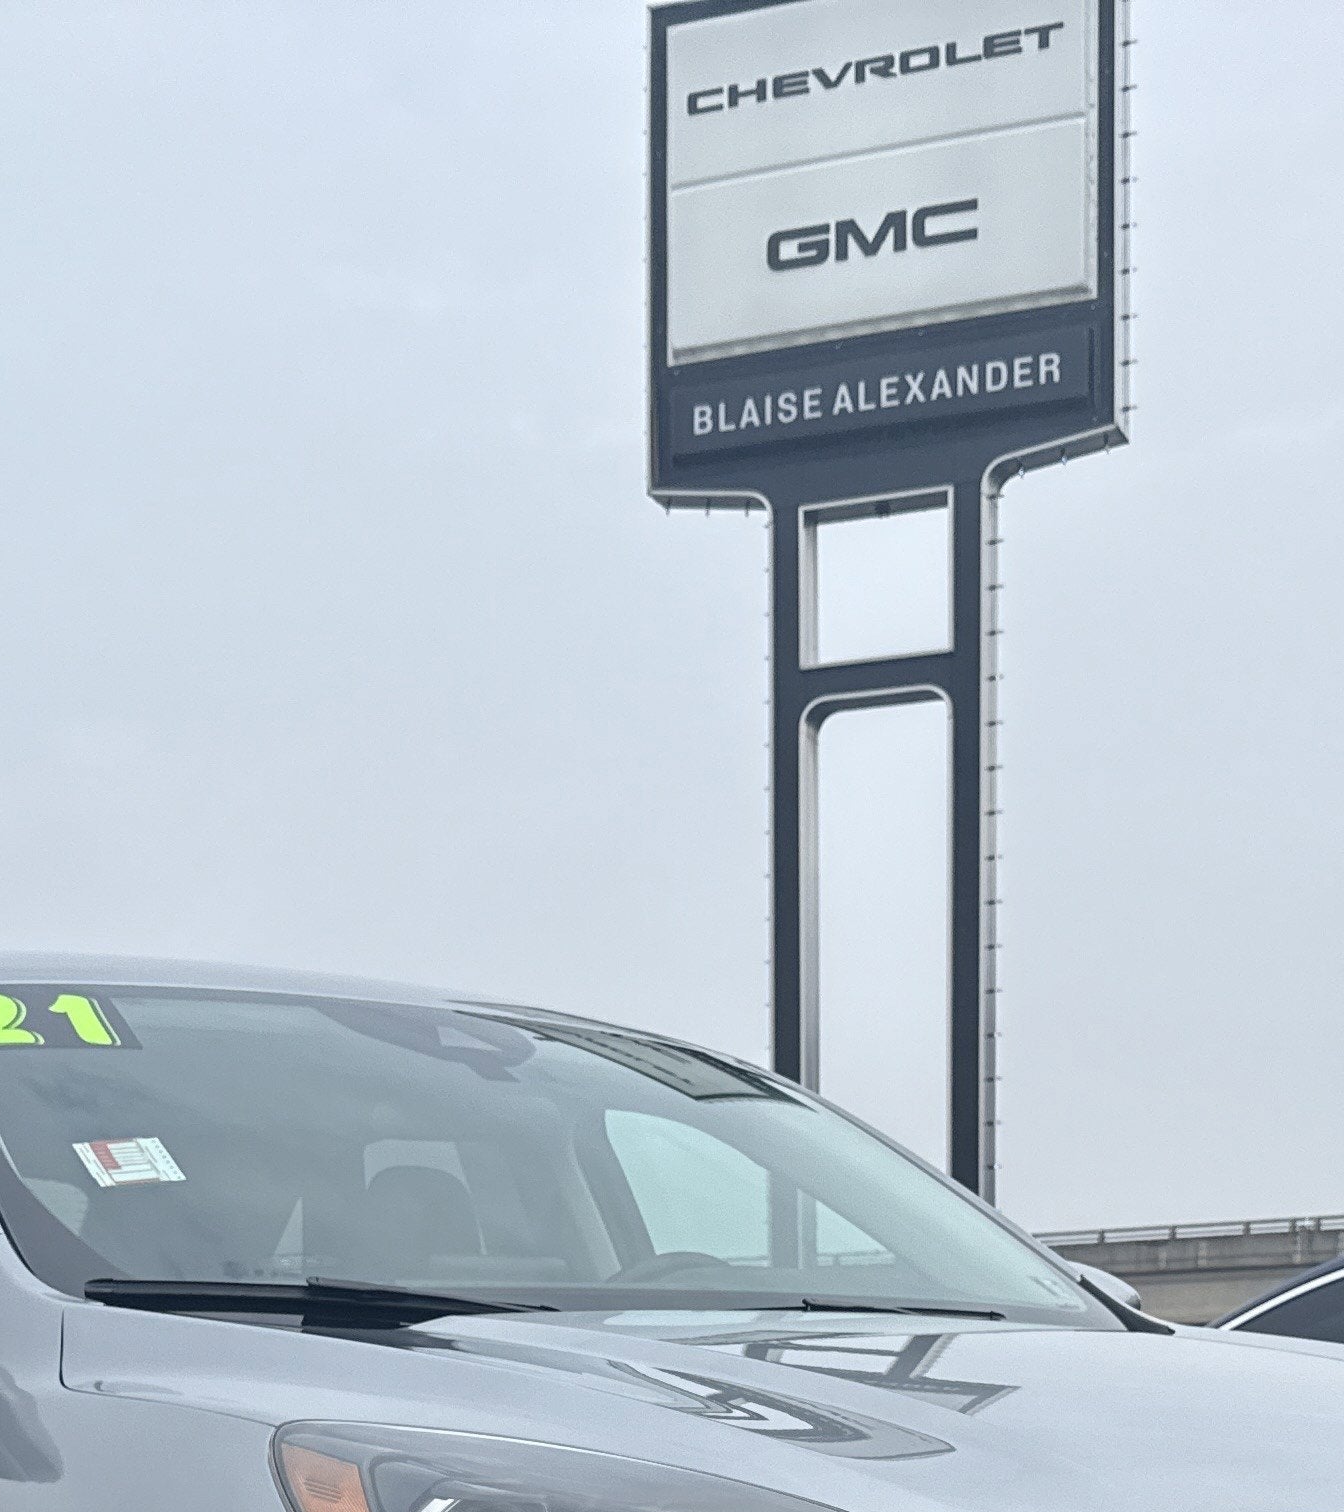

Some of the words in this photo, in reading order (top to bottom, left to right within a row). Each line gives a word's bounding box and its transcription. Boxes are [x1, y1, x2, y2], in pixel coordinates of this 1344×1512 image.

[686, 22, 1064, 116] CHEVROLET
[766, 198, 979, 272] GMC
[692, 388, 824, 436] BLAISE
[832, 353, 1062, 416] ALEXANDER
